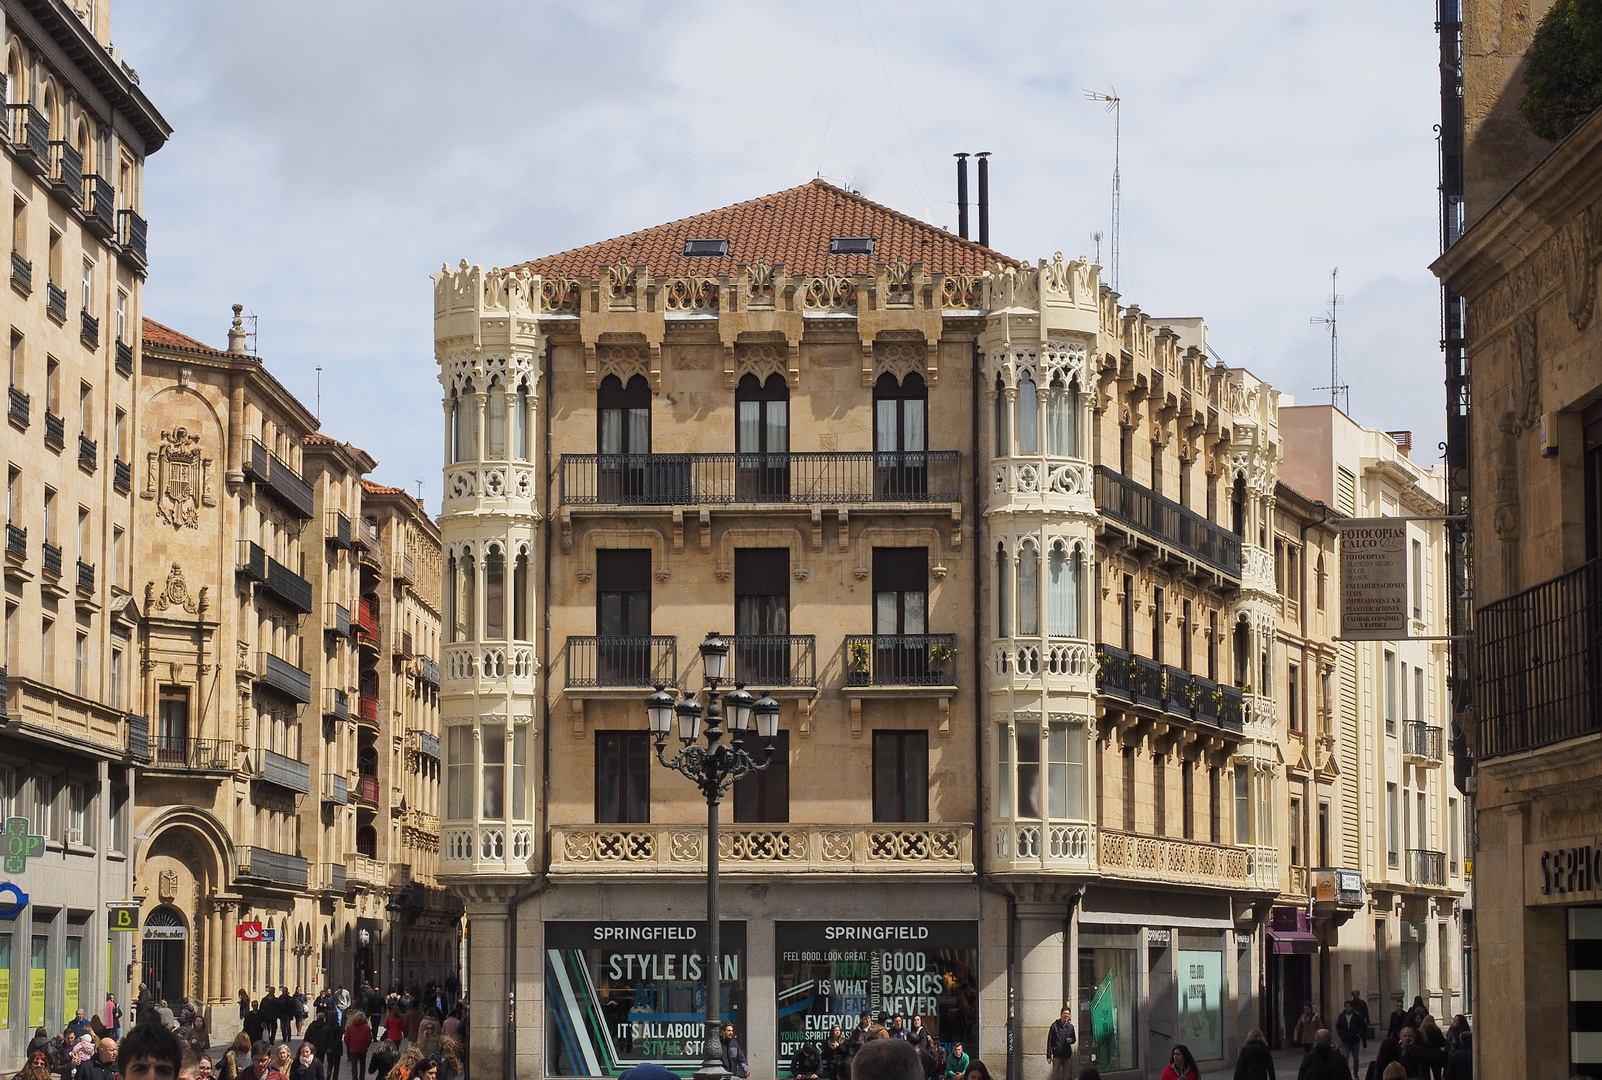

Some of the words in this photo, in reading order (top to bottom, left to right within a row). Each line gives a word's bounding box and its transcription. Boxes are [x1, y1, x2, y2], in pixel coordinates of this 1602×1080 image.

[1341, 528, 1405, 540] FOTOCOPIAS
[1342, 539, 1377, 548] CALCO
[593, 927, 697, 940] SPRINGFIELD
[825, 926, 929, 940] SPRINGFIELD
[783, 952, 800, 961] FEEL
[801, 952, 823, 962] GOOD,
[824, 952, 843, 961] LOOK
[844, 952, 869, 961] GREAT.
[871, 951, 881, 979] TODAY?
[882, 952, 926, 972] GOOD
[609, 953, 676, 981] STYLE
[683, 953, 702, 981] IS
[829, 962, 869, 978] TREND
[818, 980, 831, 995] IS
[834, 980, 869, 995] WHAT
[871, 980, 881, 993] FIT
[882, 974, 943, 995] BASICS
[633, 982, 738, 1010] ATTITUE.
[871, 993, 881, 1009] YOU
[825, 997, 829, 1013] I
[833, 997, 868, 1012] WEAR
[882, 996, 938, 1016] NEVER
[805, 1014, 861, 1030] EVERYDA
[617, 1023, 640, 1039] IT'S
[643, 1023, 668, 1039] ALL
[669, 1023, 706, 1039] ABOUT
[780, 1031, 804, 1041] YOUNG
[643, 1040, 684, 1056] STYLE.
